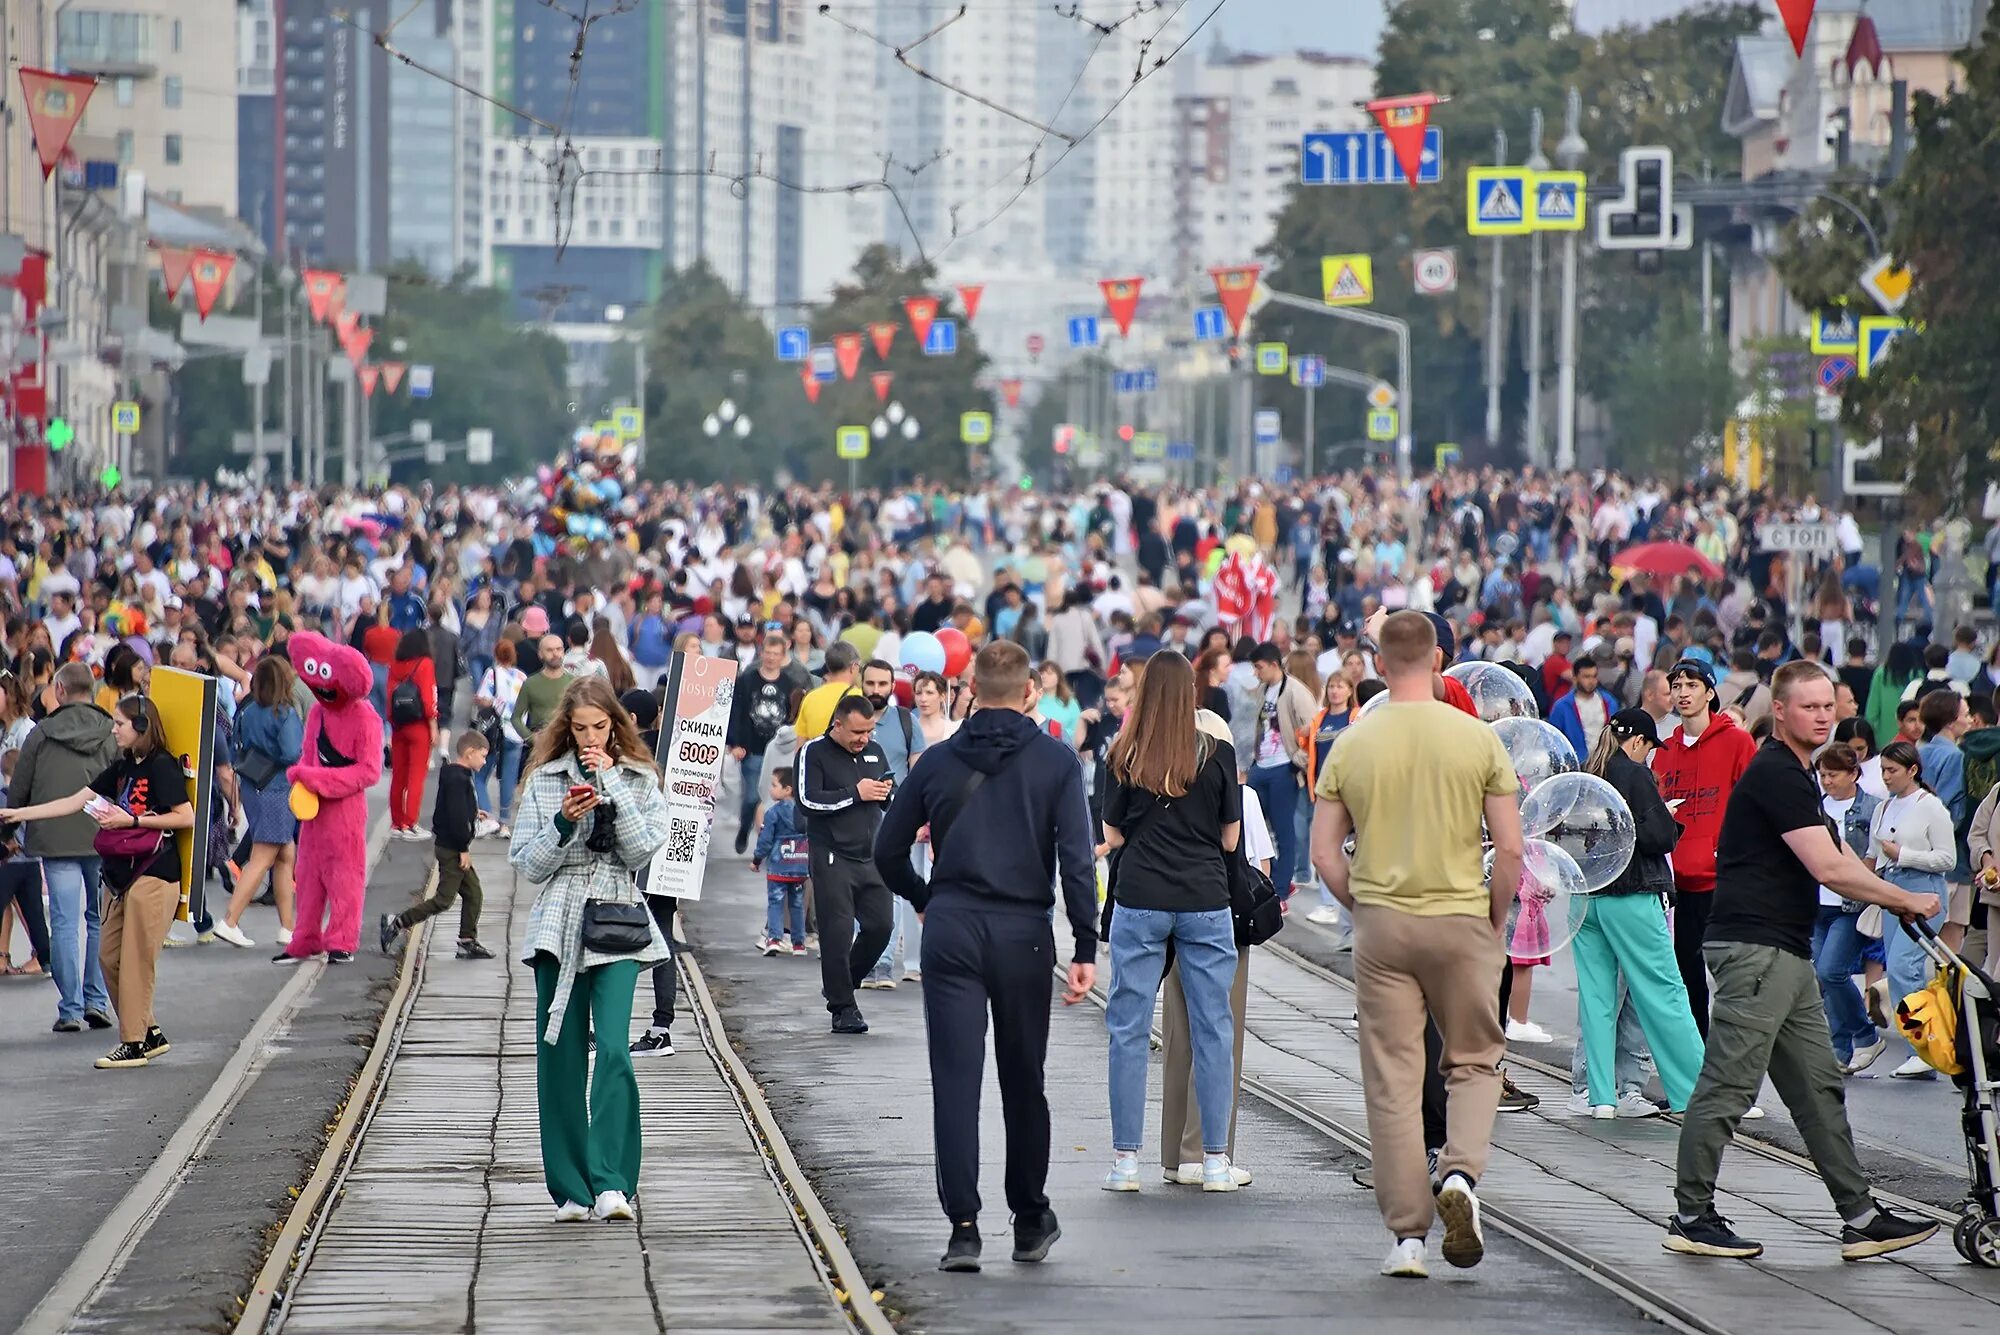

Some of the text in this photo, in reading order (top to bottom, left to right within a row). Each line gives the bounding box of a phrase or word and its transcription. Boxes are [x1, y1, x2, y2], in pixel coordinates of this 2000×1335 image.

[680, 719, 723, 737] СКИДКА
[671, 767, 716, 781] по промокоду
[672, 781, 711, 798] «ЛЕТО»
